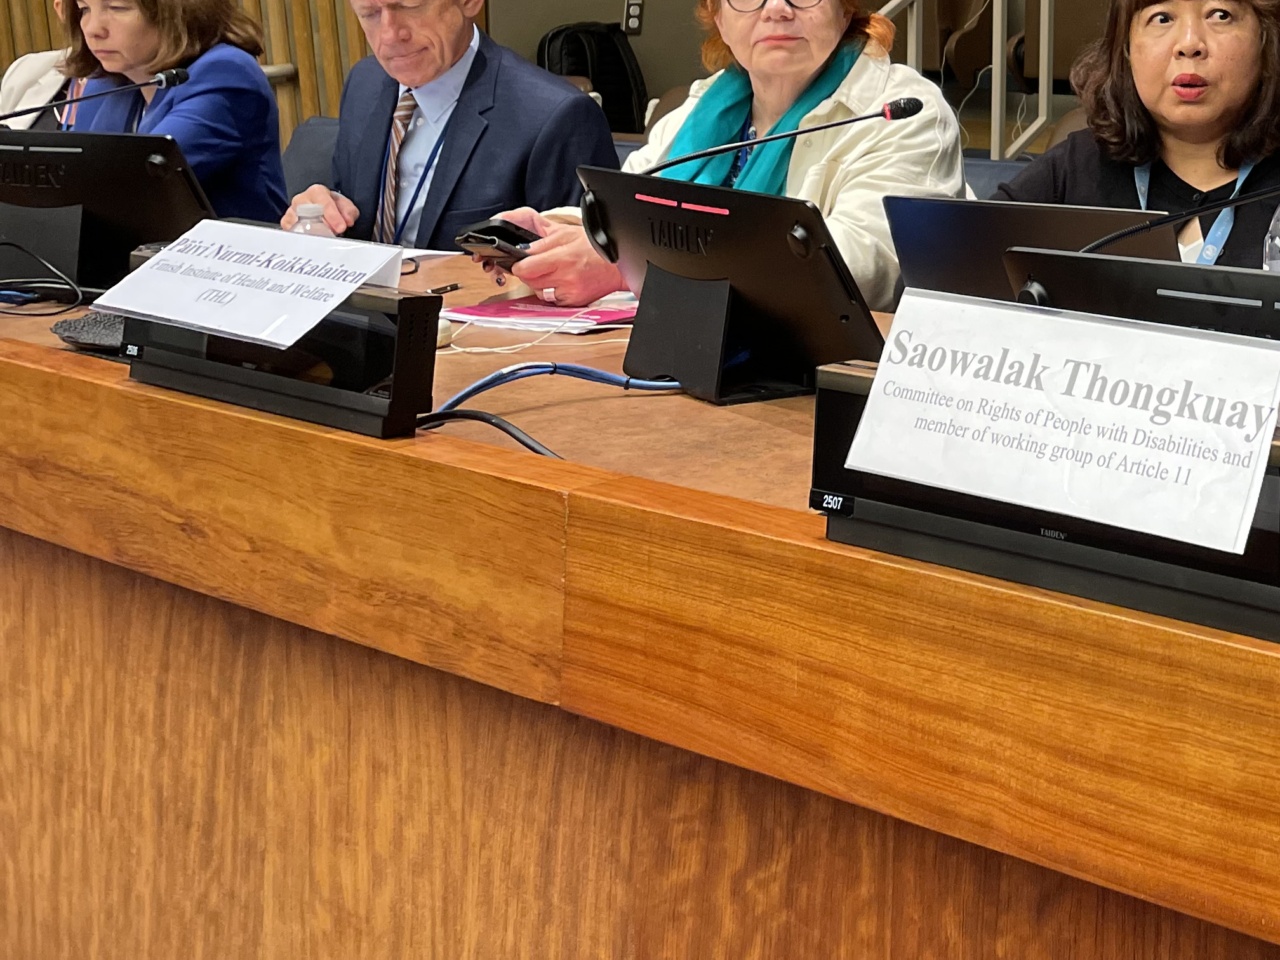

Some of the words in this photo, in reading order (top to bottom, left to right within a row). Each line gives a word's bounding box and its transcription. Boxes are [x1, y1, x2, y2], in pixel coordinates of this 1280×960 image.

[168, 238, 215, 258] Päivi
[204, 244, 367, 284] Nurmi-Koikkalainen
[195, 288, 238, 307] (THL)
[220, 272, 241, 283] of
[232, 272, 271, 290] Health
[266, 282, 295, 294] and
[290, 283, 334, 302] Welfare
[886, 329, 1050, 391] Saowalak
[1060, 358, 1275, 442] Thongkuay
[882, 380, 953, 408] Committee
[956, 397, 974, 412] on
[976, 398, 1022, 422] Rights
[1024, 408, 1044, 426] of
[1043, 410, 1092, 437] People
[1096, 422, 1128, 443] with
[1131, 428, 1219, 462] Disabilities
[1222, 451, 1253, 469] and
[913, 416, 970, 438] member
[971, 426, 991, 442] of
[991, 433, 1049, 460] working
[1049, 444, 1093, 468] group
[1096, 451, 1117, 469] of
[1115, 454, 1169, 481] Article
[1174, 465, 1192, 486] 11
[822, 494, 843, 510] 2507
